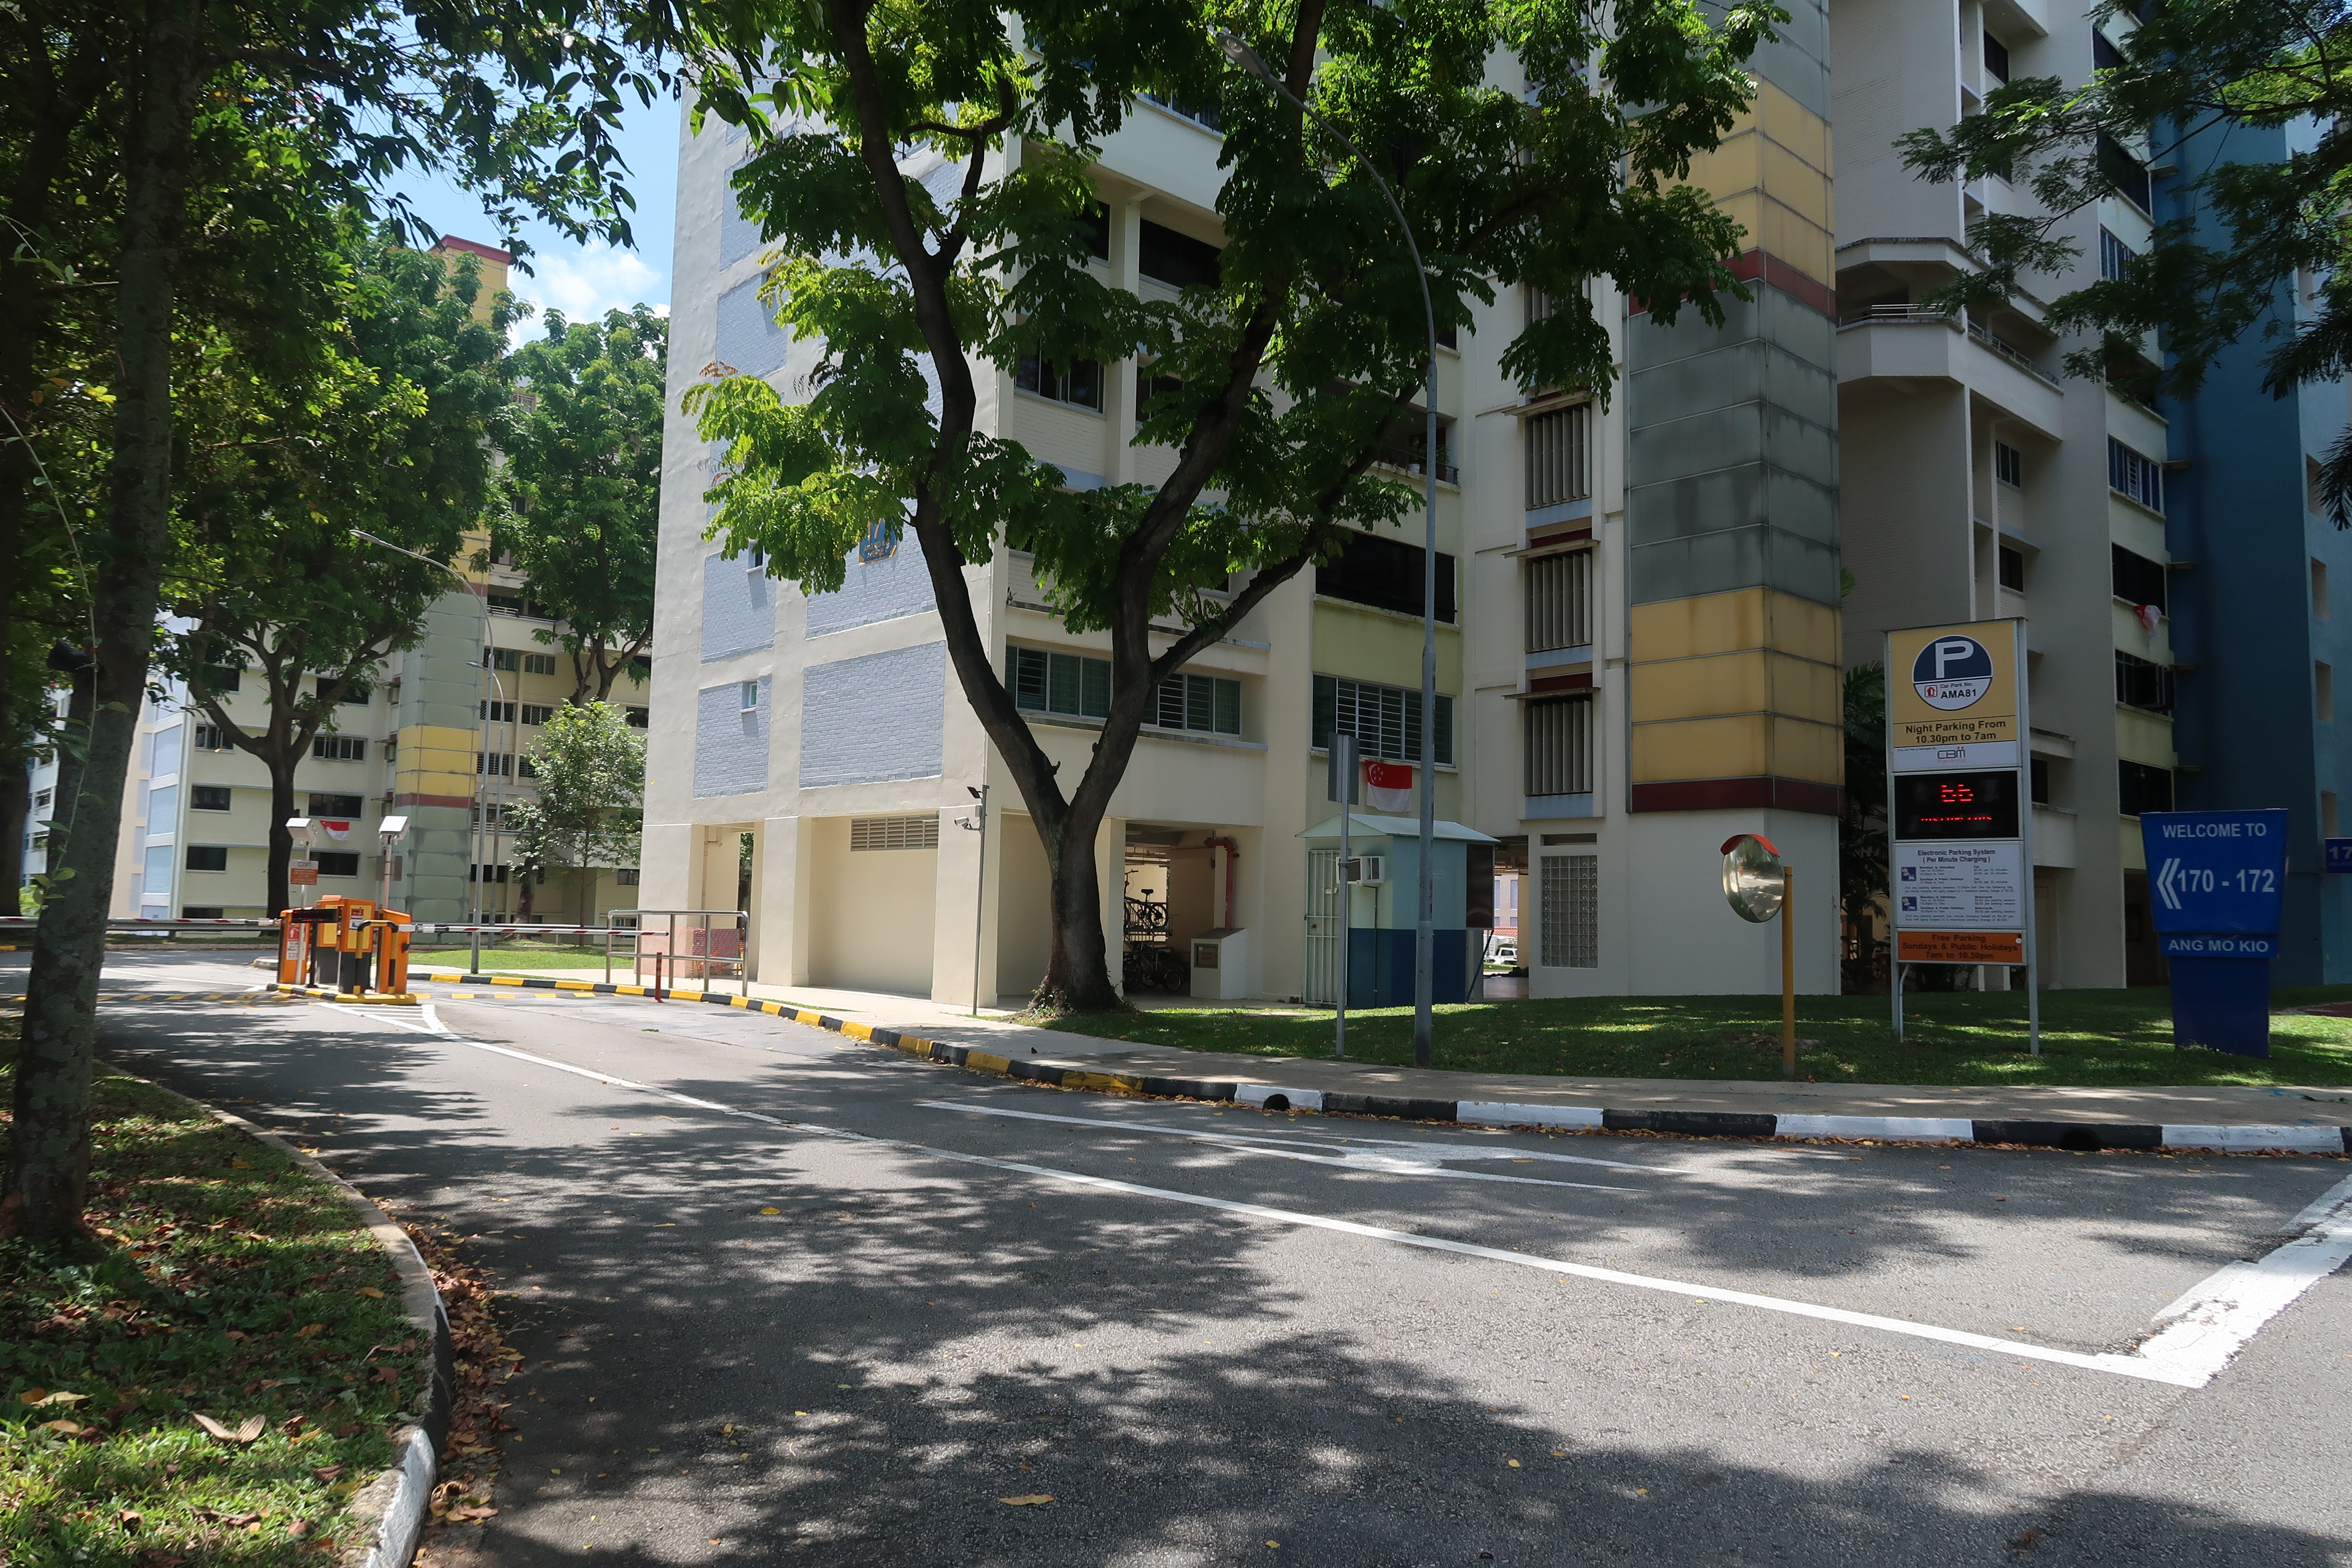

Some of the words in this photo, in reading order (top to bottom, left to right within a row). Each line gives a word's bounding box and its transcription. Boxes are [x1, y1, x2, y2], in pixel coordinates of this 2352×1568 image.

[1935, 640, 1974, 679] P
[1940, 689, 1976, 699] AMA81
[1906, 725, 1932, 735] Night
[1936, 722, 1975, 731] Parking
[1915, 735, 1958, 744] 10.30pm
[2162, 823, 2241, 838] WELCOME
[2245, 823, 2267, 836] TO
[2177, 869, 2214, 892] 170
[2236, 869, 2275, 892] 172
[1954, 934, 1986, 943] Parking
[1902, 942, 1938, 950] Sundays
[1980, 943, 2018, 952] Holidays
[2168, 940, 2203, 951] ANG
[2208, 940, 2234, 952] MO
[2239, 940, 2269, 952] KIO
[1959, 952, 1994, 960] 10.30pm
